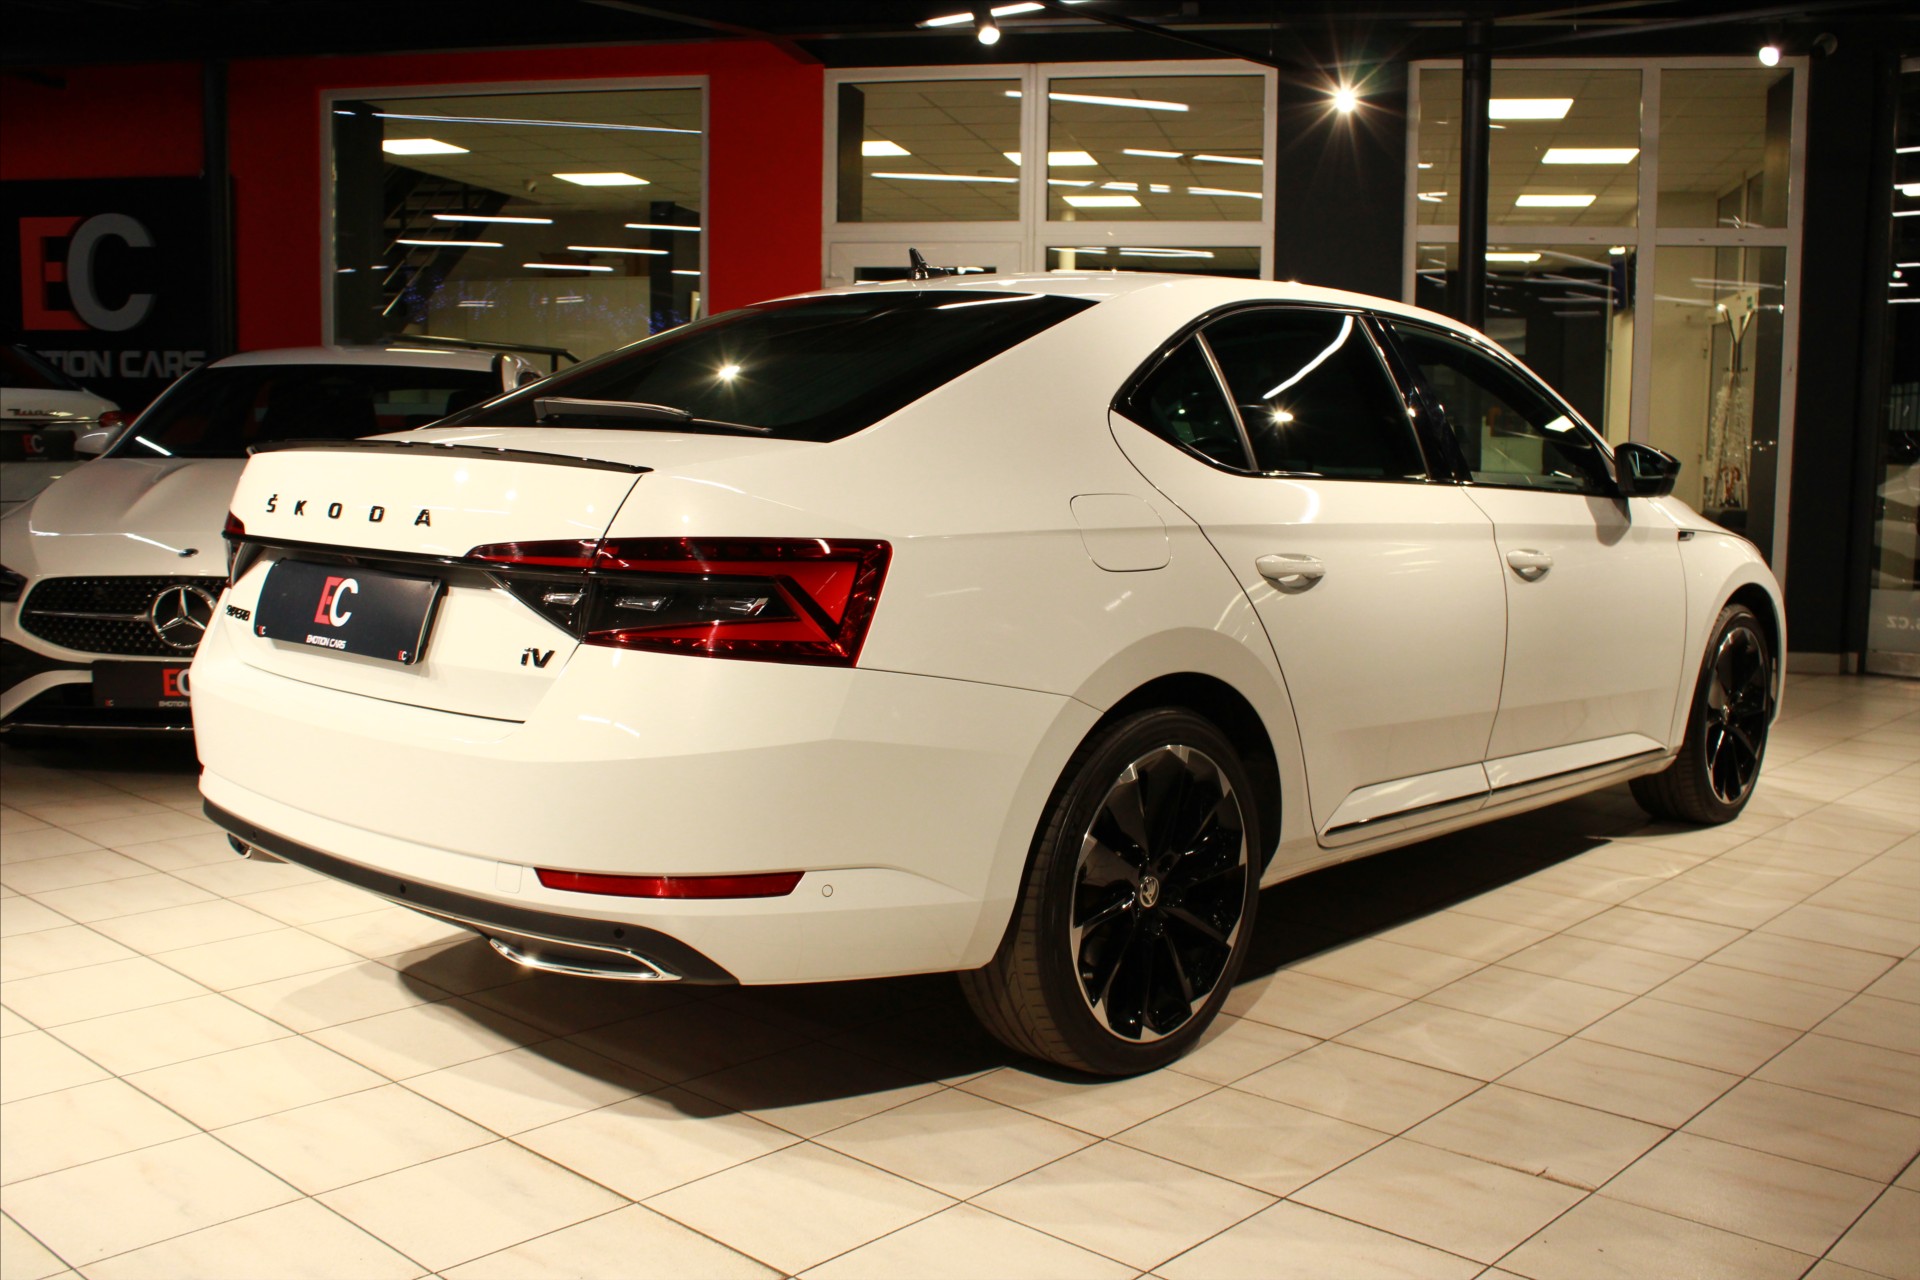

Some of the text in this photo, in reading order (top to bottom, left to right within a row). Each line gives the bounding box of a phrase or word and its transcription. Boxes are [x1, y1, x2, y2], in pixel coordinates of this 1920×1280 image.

[19, 212, 156, 332] EC
[35, 349, 112, 378] TION
[314, 575, 359, 628] EC
[329, 638, 347, 650] CARS
